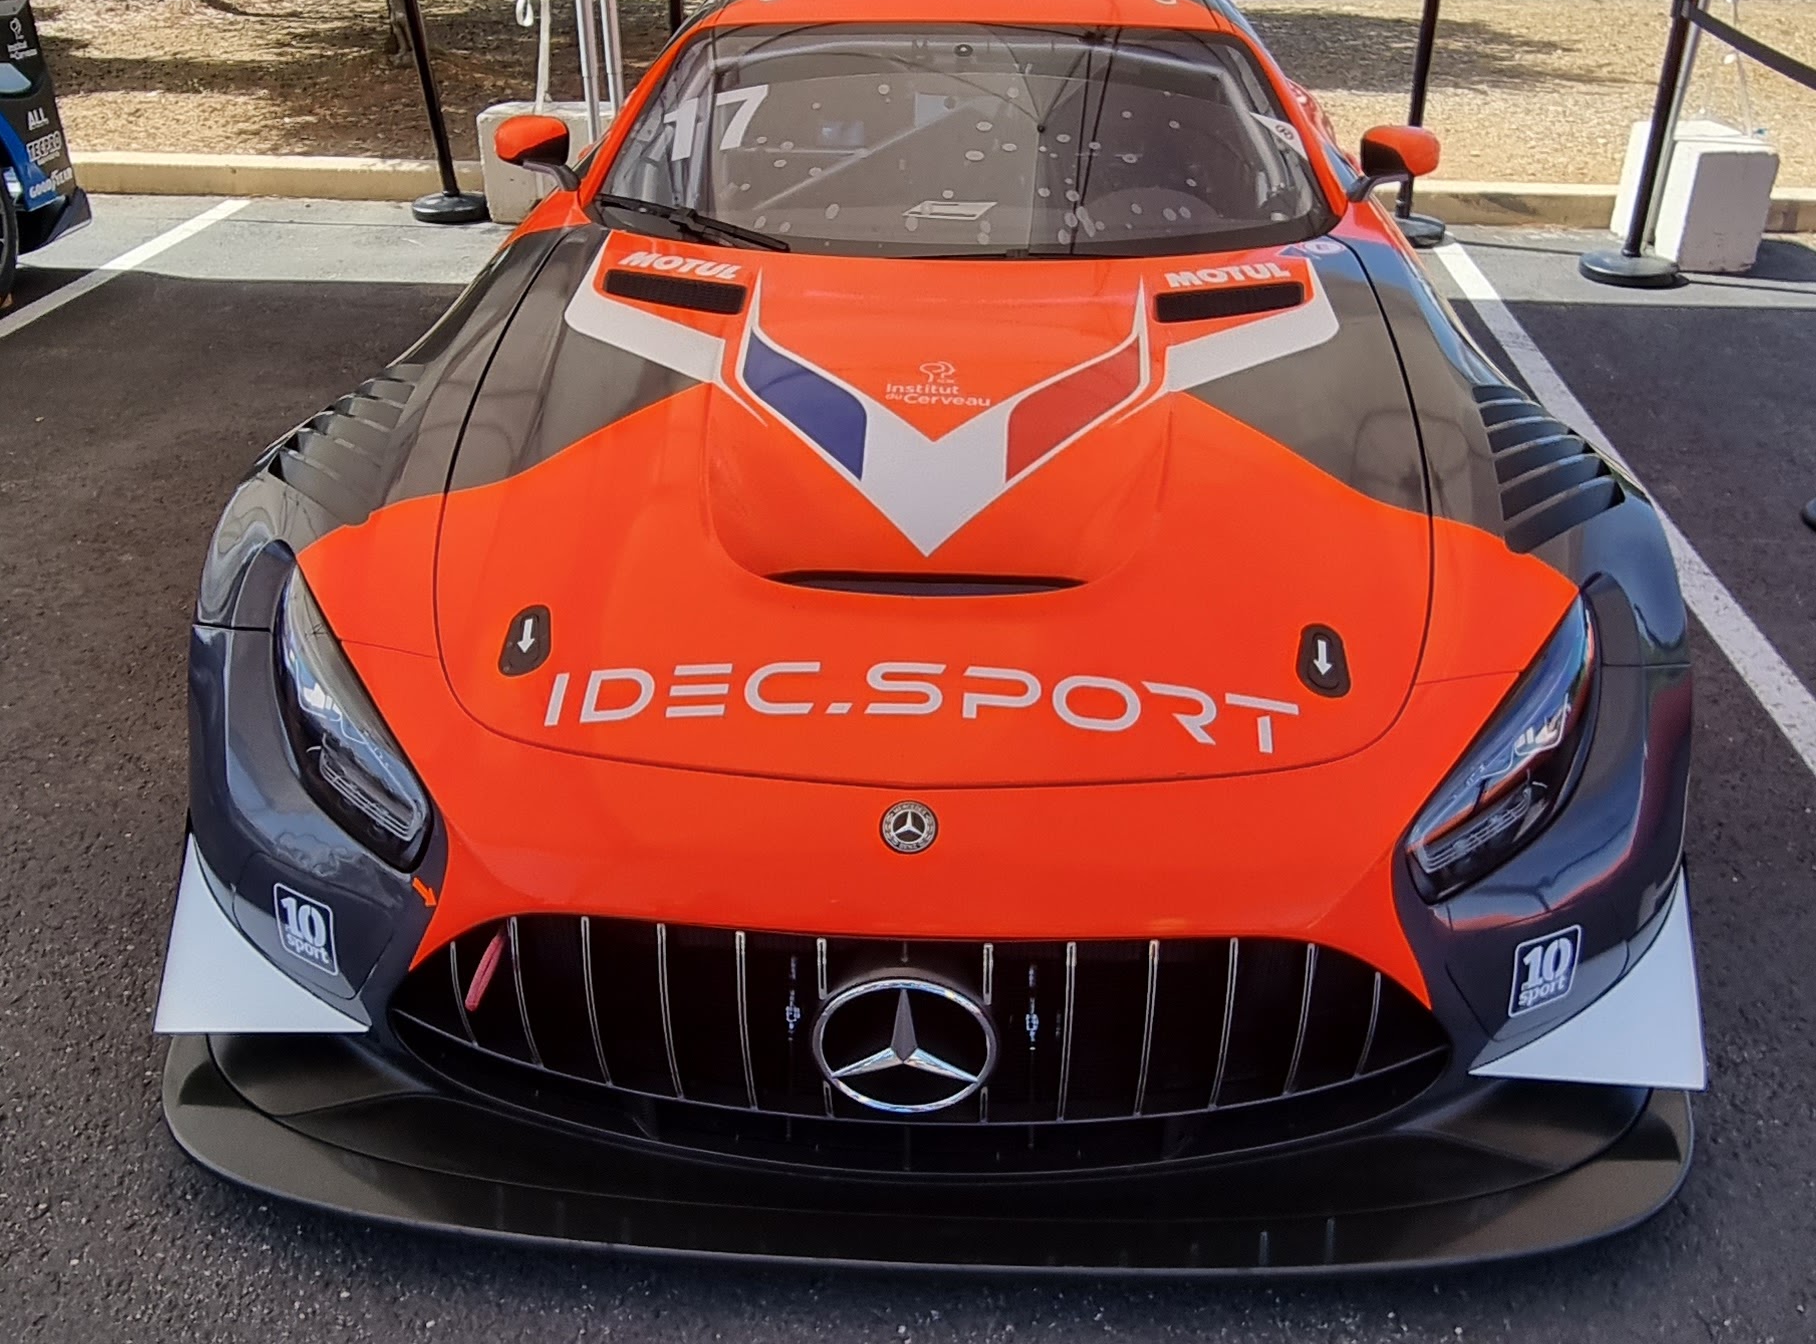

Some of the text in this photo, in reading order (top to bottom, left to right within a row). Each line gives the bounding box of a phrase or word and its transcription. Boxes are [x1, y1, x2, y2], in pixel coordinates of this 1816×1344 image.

[663, 84, 769, 161] 17
[617, 251, 742, 280] MOTUL
[1164, 262, 1292, 288] MOTUL
[884, 393, 991, 407] du Cerveau
[885, 383, 960, 395] Institut
[544, 661, 1300, 754] IDEC.SPORT
[280, 896, 327, 948] 10
[286, 932, 330, 964] sport
[1521, 937, 1574, 991] 10
[1518, 974, 1568, 1007] sport
